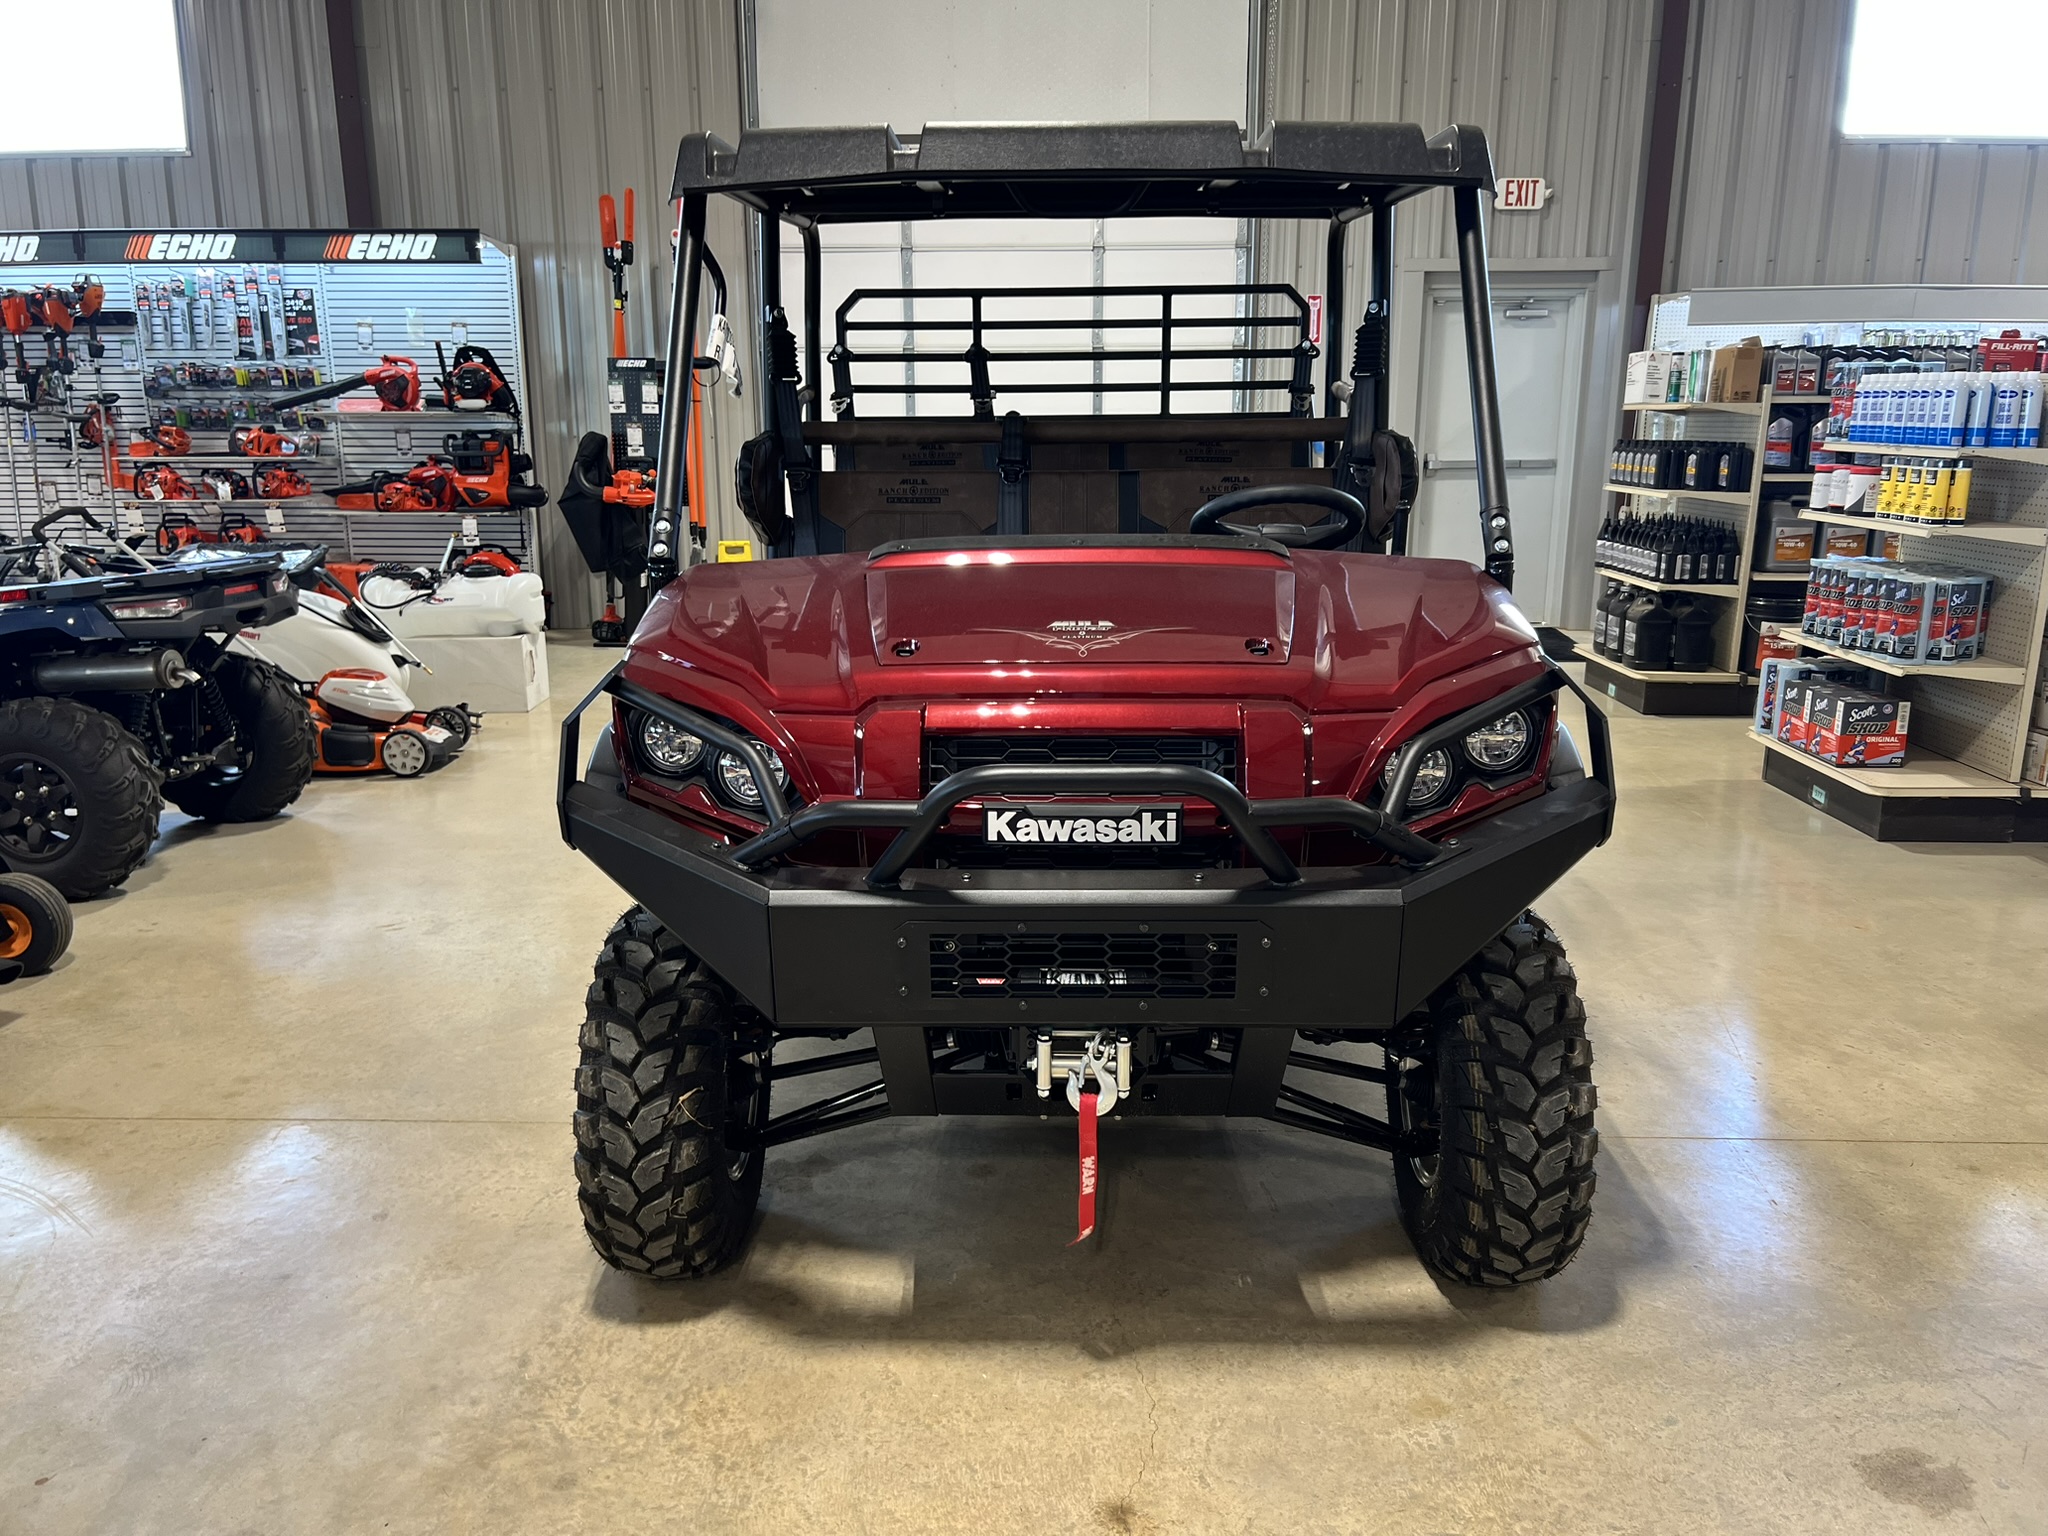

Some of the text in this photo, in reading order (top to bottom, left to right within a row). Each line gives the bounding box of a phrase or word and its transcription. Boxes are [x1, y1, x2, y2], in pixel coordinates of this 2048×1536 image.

[1504, 180, 1539, 207] EXIT
[0, 235, 40, 262] HO
[147, 234, 237, 260] ECHO
[347, 233, 437, 260] ECHO
[1991, 342, 2034, 350] FILL-RITE
[622, 359, 647, 367] ECHO
[1784, 702, 1801, 717] SHOP
[1813, 712, 1833, 728] SHOP
[1849, 704, 1876, 722] Scott
[1847, 722, 1889, 734] SHOP
[987, 811, 1177, 843] Kawasaki
[1082, 1155, 1095, 1195] WARN
